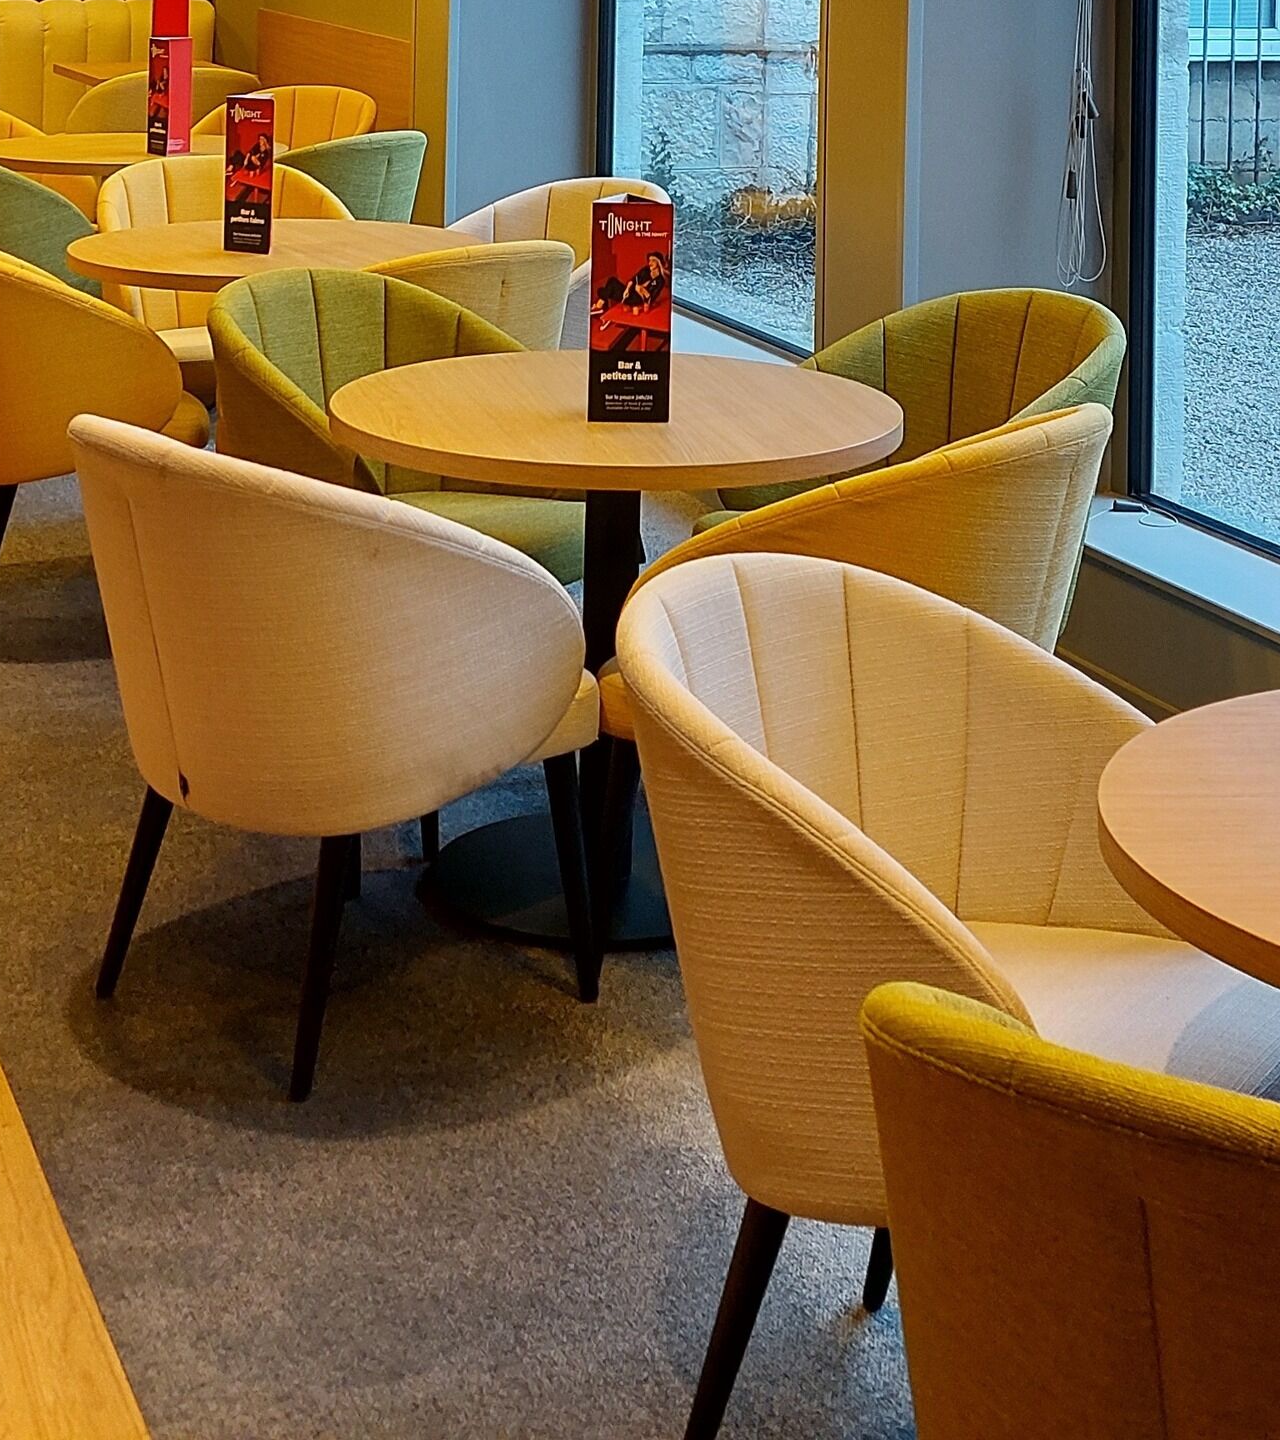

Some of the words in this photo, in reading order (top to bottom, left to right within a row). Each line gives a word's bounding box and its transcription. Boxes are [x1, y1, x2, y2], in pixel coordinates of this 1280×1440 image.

[598, 212, 653, 239] TONIGHT
[617, 361, 634, 370] Bar
[634, 361, 642, 370] &
[600, 371, 633, 383] petites
[633, 371, 659, 381] faims
